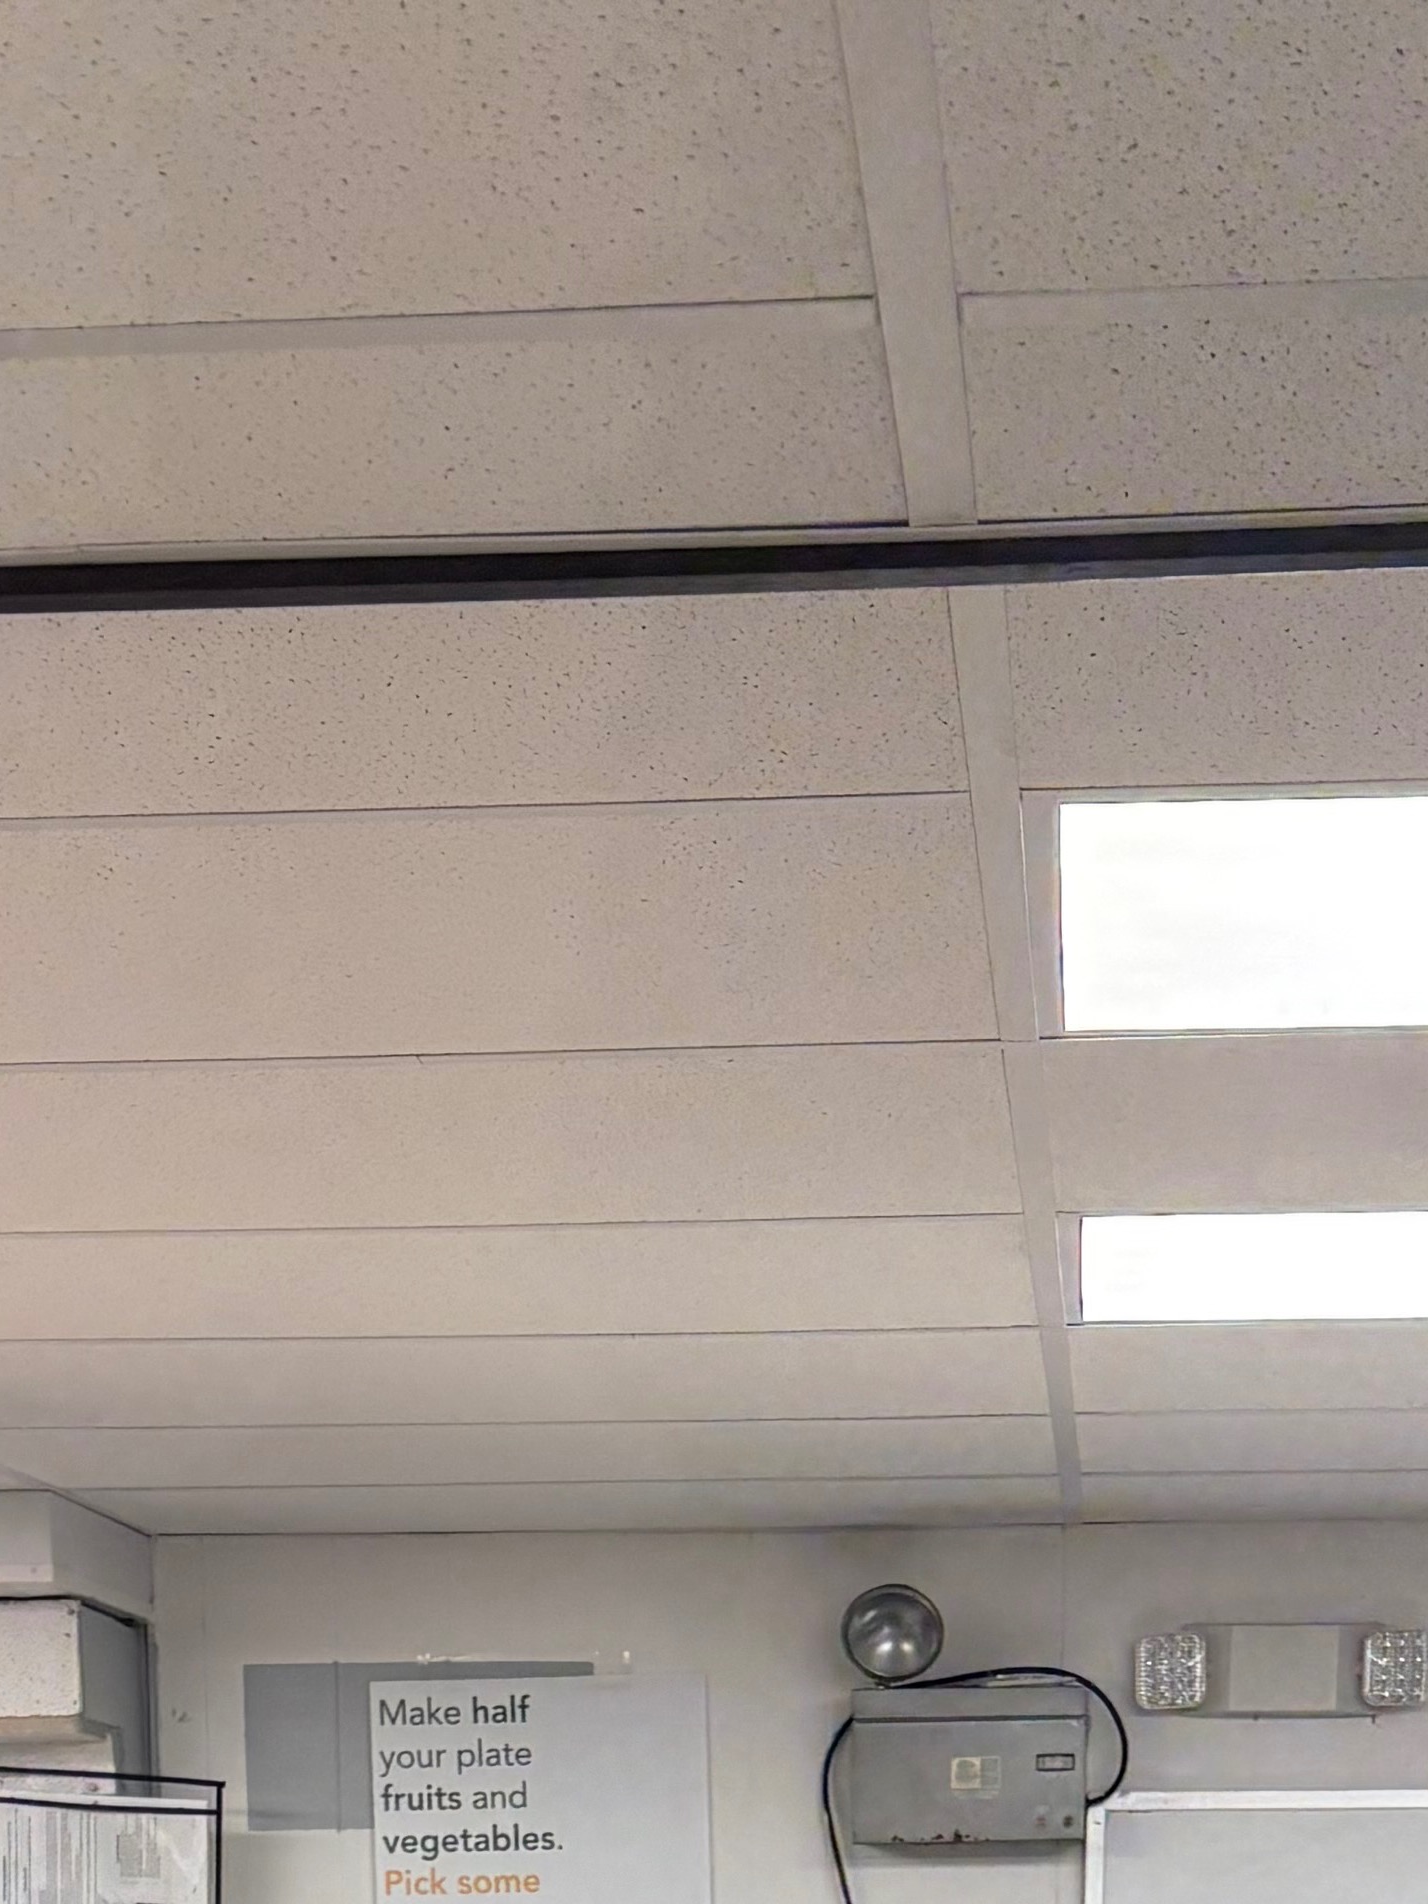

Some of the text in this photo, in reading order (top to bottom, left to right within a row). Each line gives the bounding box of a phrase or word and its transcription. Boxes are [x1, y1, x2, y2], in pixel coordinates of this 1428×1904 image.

[379, 1695, 530, 1726] Make half
[379, 1738, 532, 1777] your plate
[380, 1780, 527, 1812] fruits and
[382, 1823, 563, 1861] vegetables.
[384, 1867, 540, 1896] Pick some
